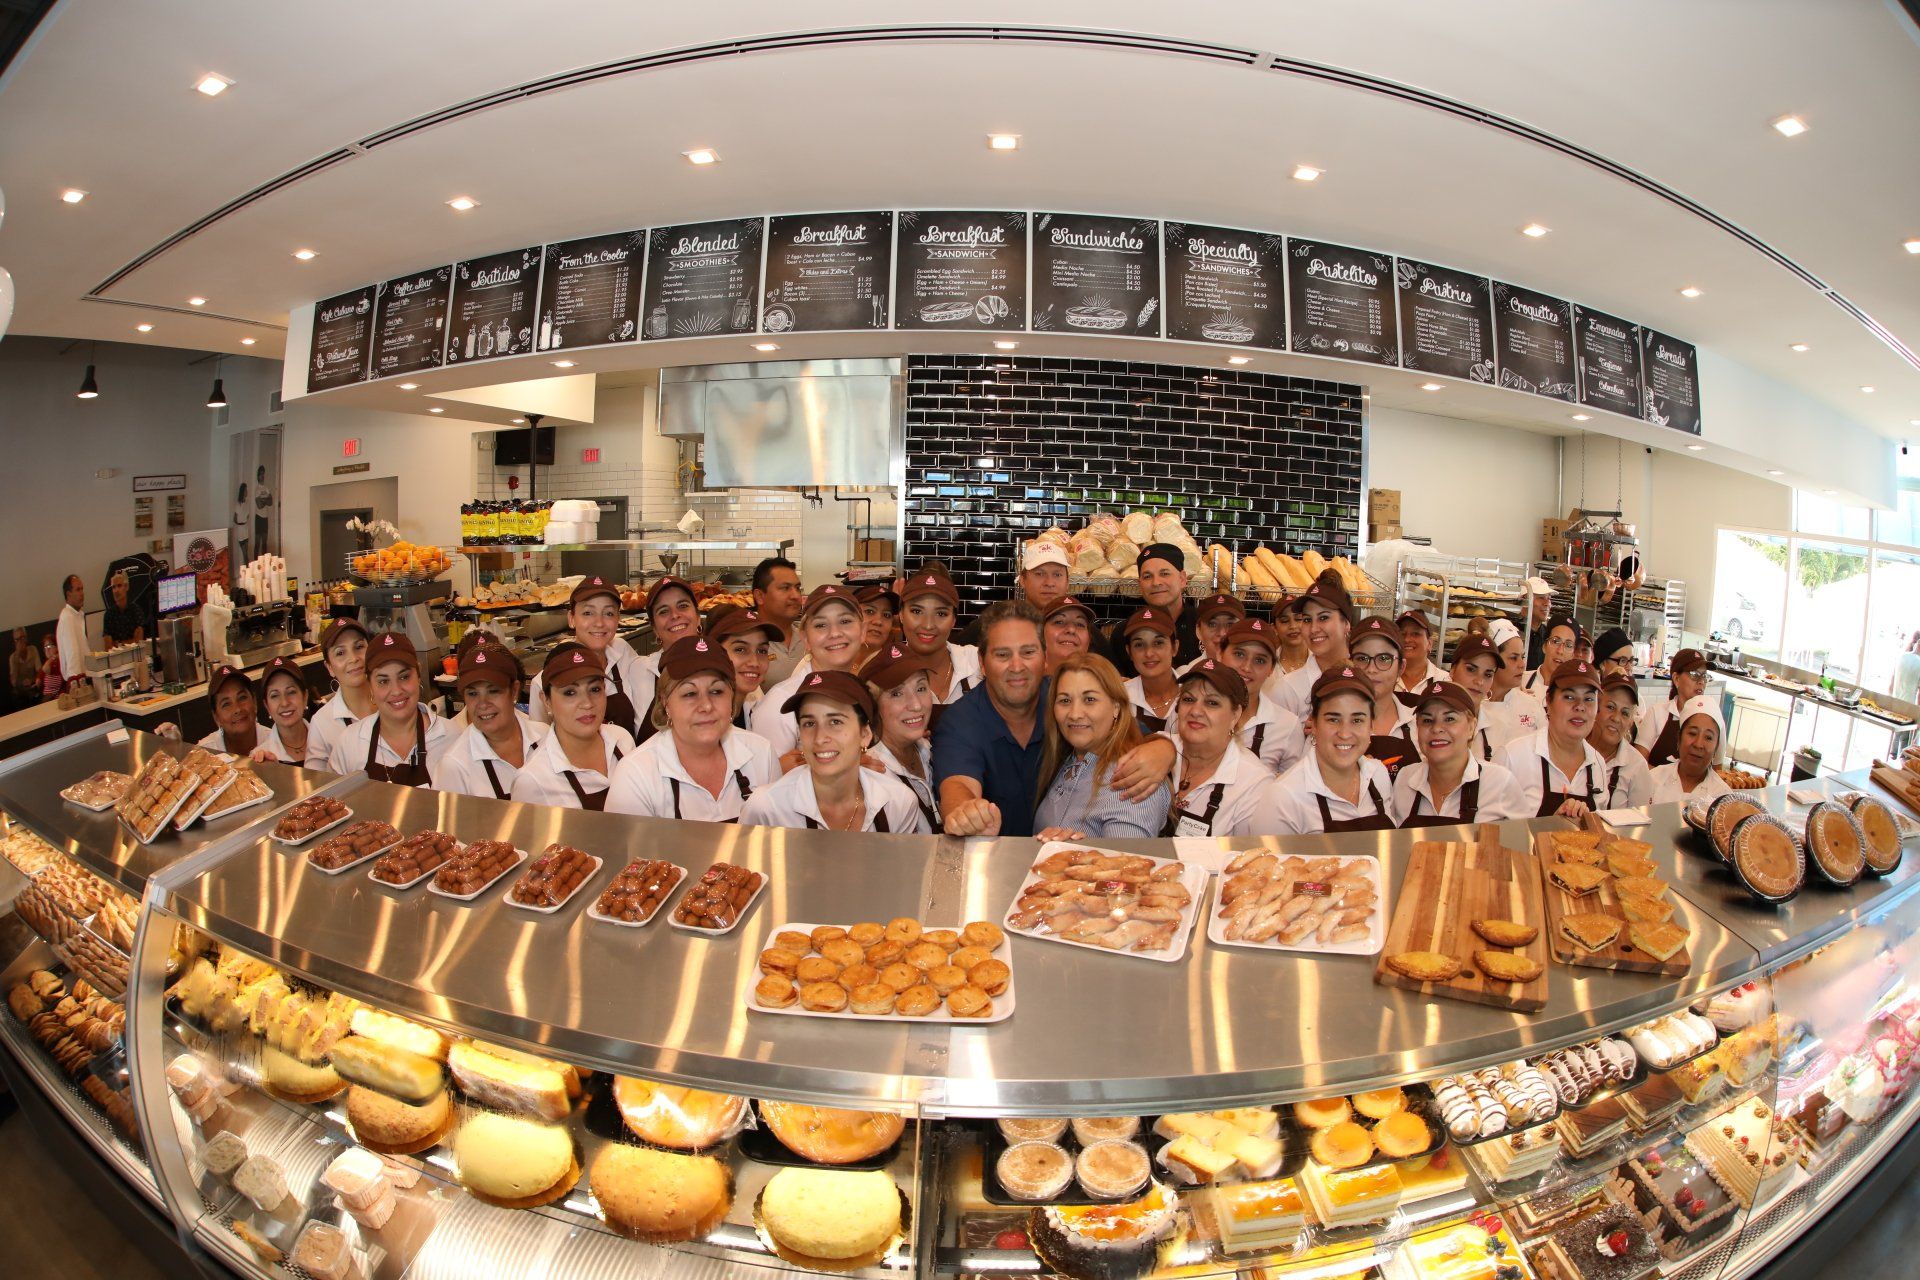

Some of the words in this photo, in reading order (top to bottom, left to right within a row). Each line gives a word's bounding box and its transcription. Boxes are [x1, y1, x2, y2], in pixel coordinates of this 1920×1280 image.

[670, 232, 740, 256] Blended
[793, 224, 866, 246] Breakfast
[920, 226, 1004, 248] Breakfast
[1051, 228, 1144, 250] Sandwiches
[559, 254, 583, 269] From
[583, 252, 599, 264] the
[600, 248, 628, 262] Cooler
[679, 257, 726, 269] SMOOTHIES
[936, 250, 985, 258] SANDWICH
[1188, 238, 1258, 267] Specialty
[471, 266, 520, 288] Batidos
[1200, 264, 1250, 275] SANDWICHES
[1307, 258, 1378, 286] Pastelitos
[1420, 278, 1472, 303] Pastries
[1510, 296, 1558, 323] Croquettes
